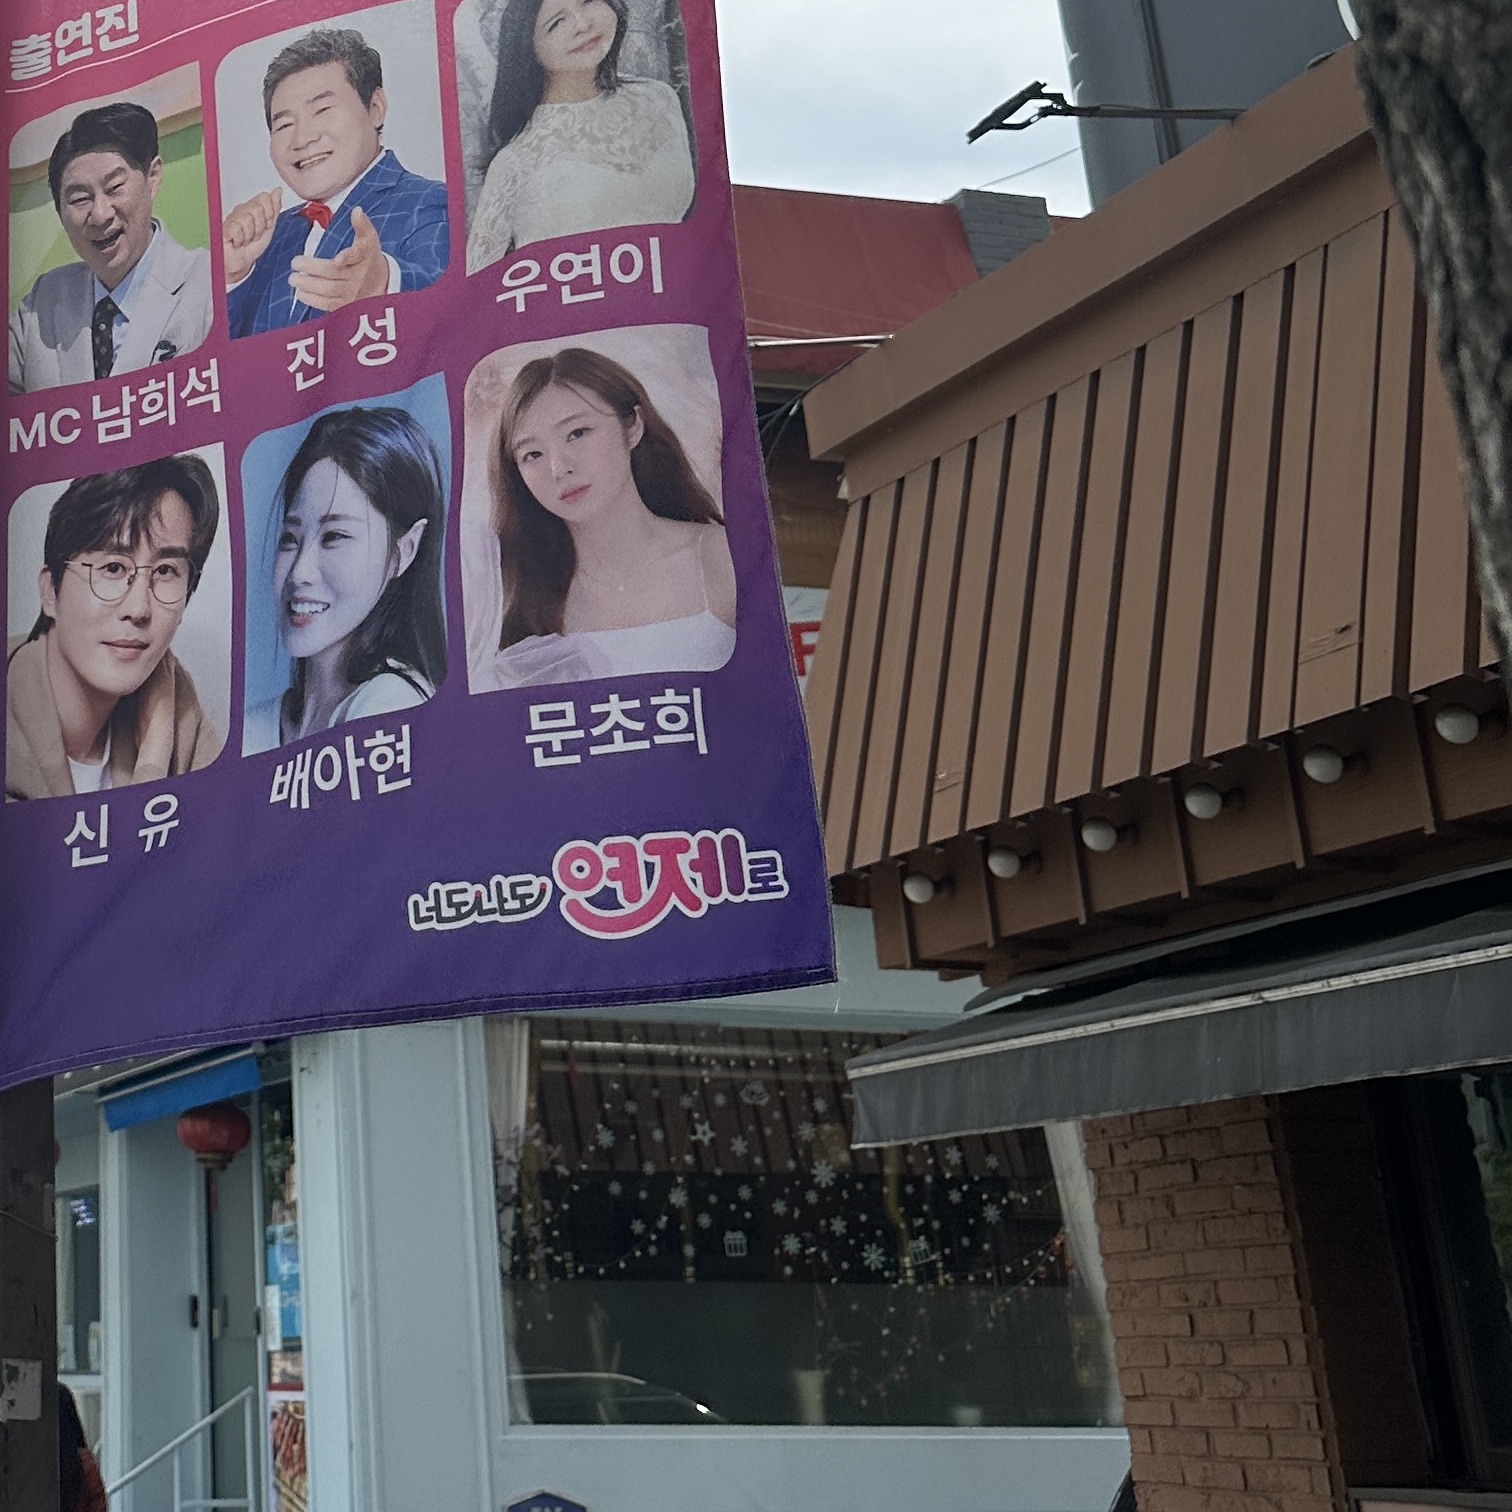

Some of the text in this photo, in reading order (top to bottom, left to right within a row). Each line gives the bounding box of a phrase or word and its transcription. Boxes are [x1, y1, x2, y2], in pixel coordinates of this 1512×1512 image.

[495, 235, 665, 314] 우연이
[8, 357, 223, 454] MC 남희석
[268, 722, 415, 812] 배아현
[524, 685, 710, 770] 문초희
[412, 833, 786, 934] 너도나도 연제로
